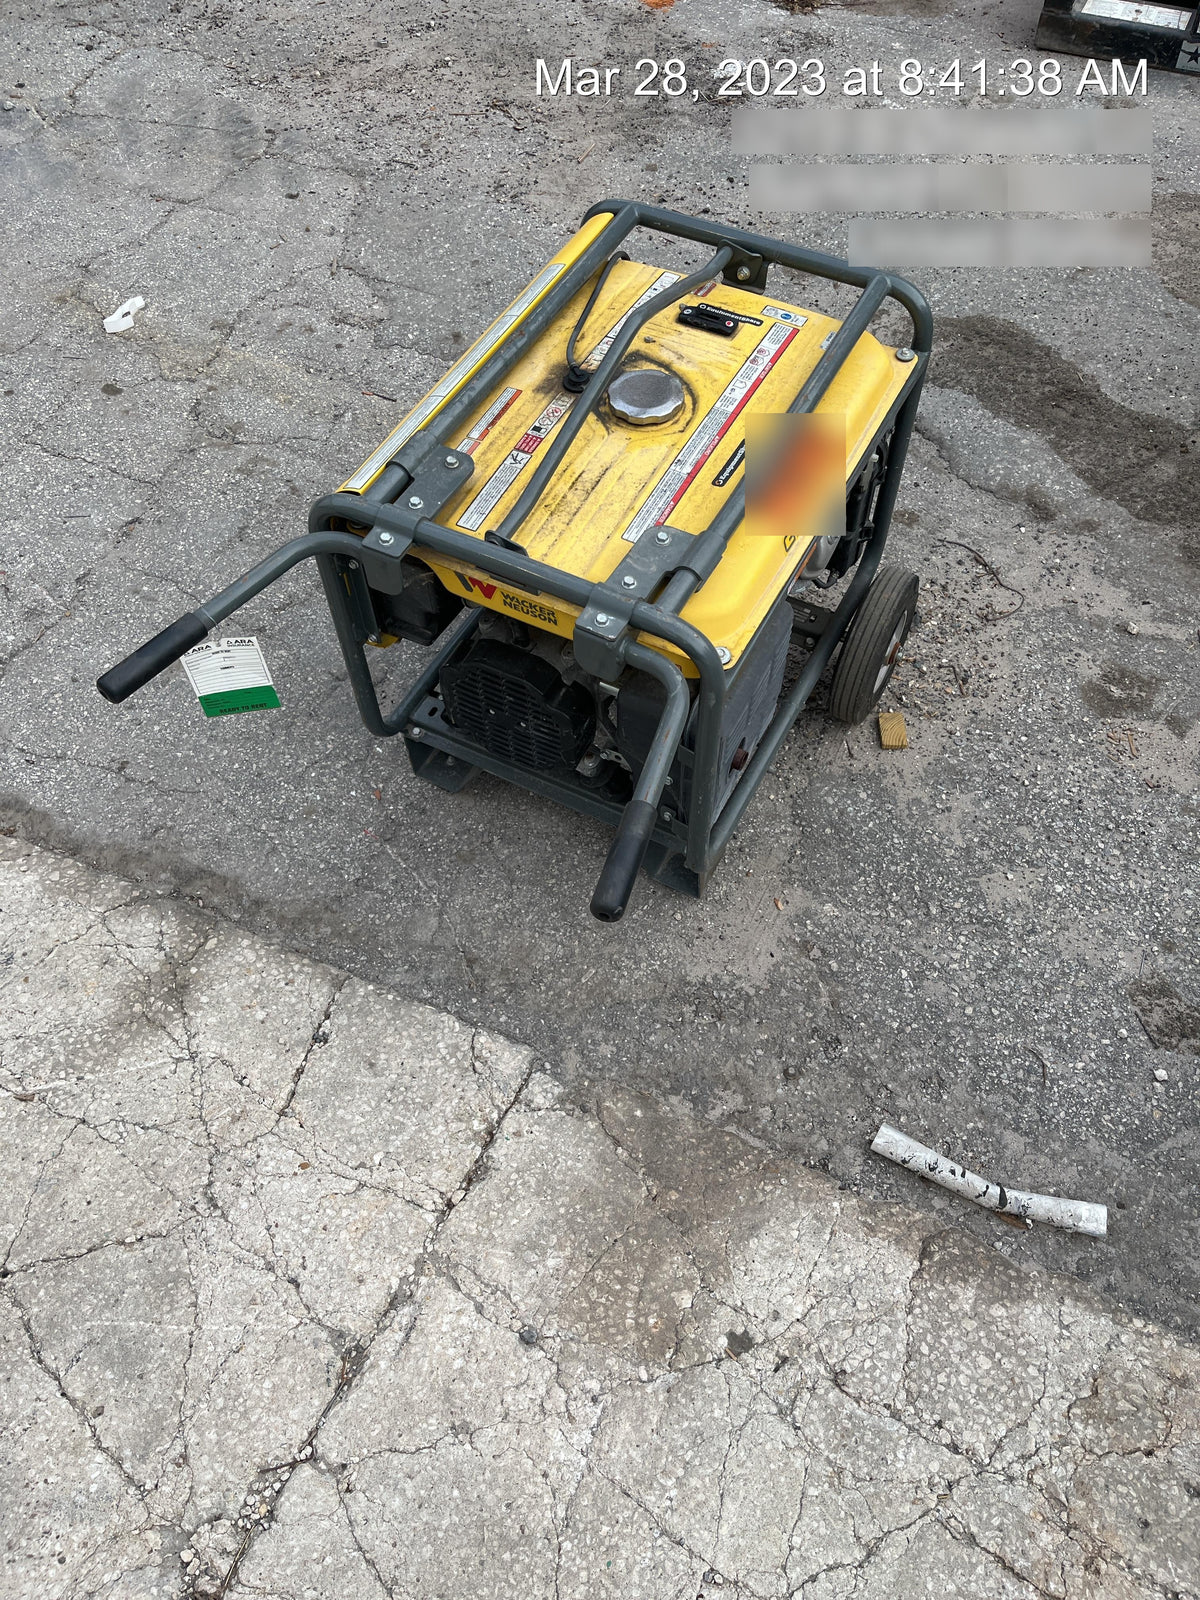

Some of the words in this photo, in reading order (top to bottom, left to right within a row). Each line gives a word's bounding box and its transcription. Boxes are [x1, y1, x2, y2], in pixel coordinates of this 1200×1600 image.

[501, 591, 556, 618] WACKER
[502, 599, 558, 626] NEUSON
[219, 706, 240, 714] READY
